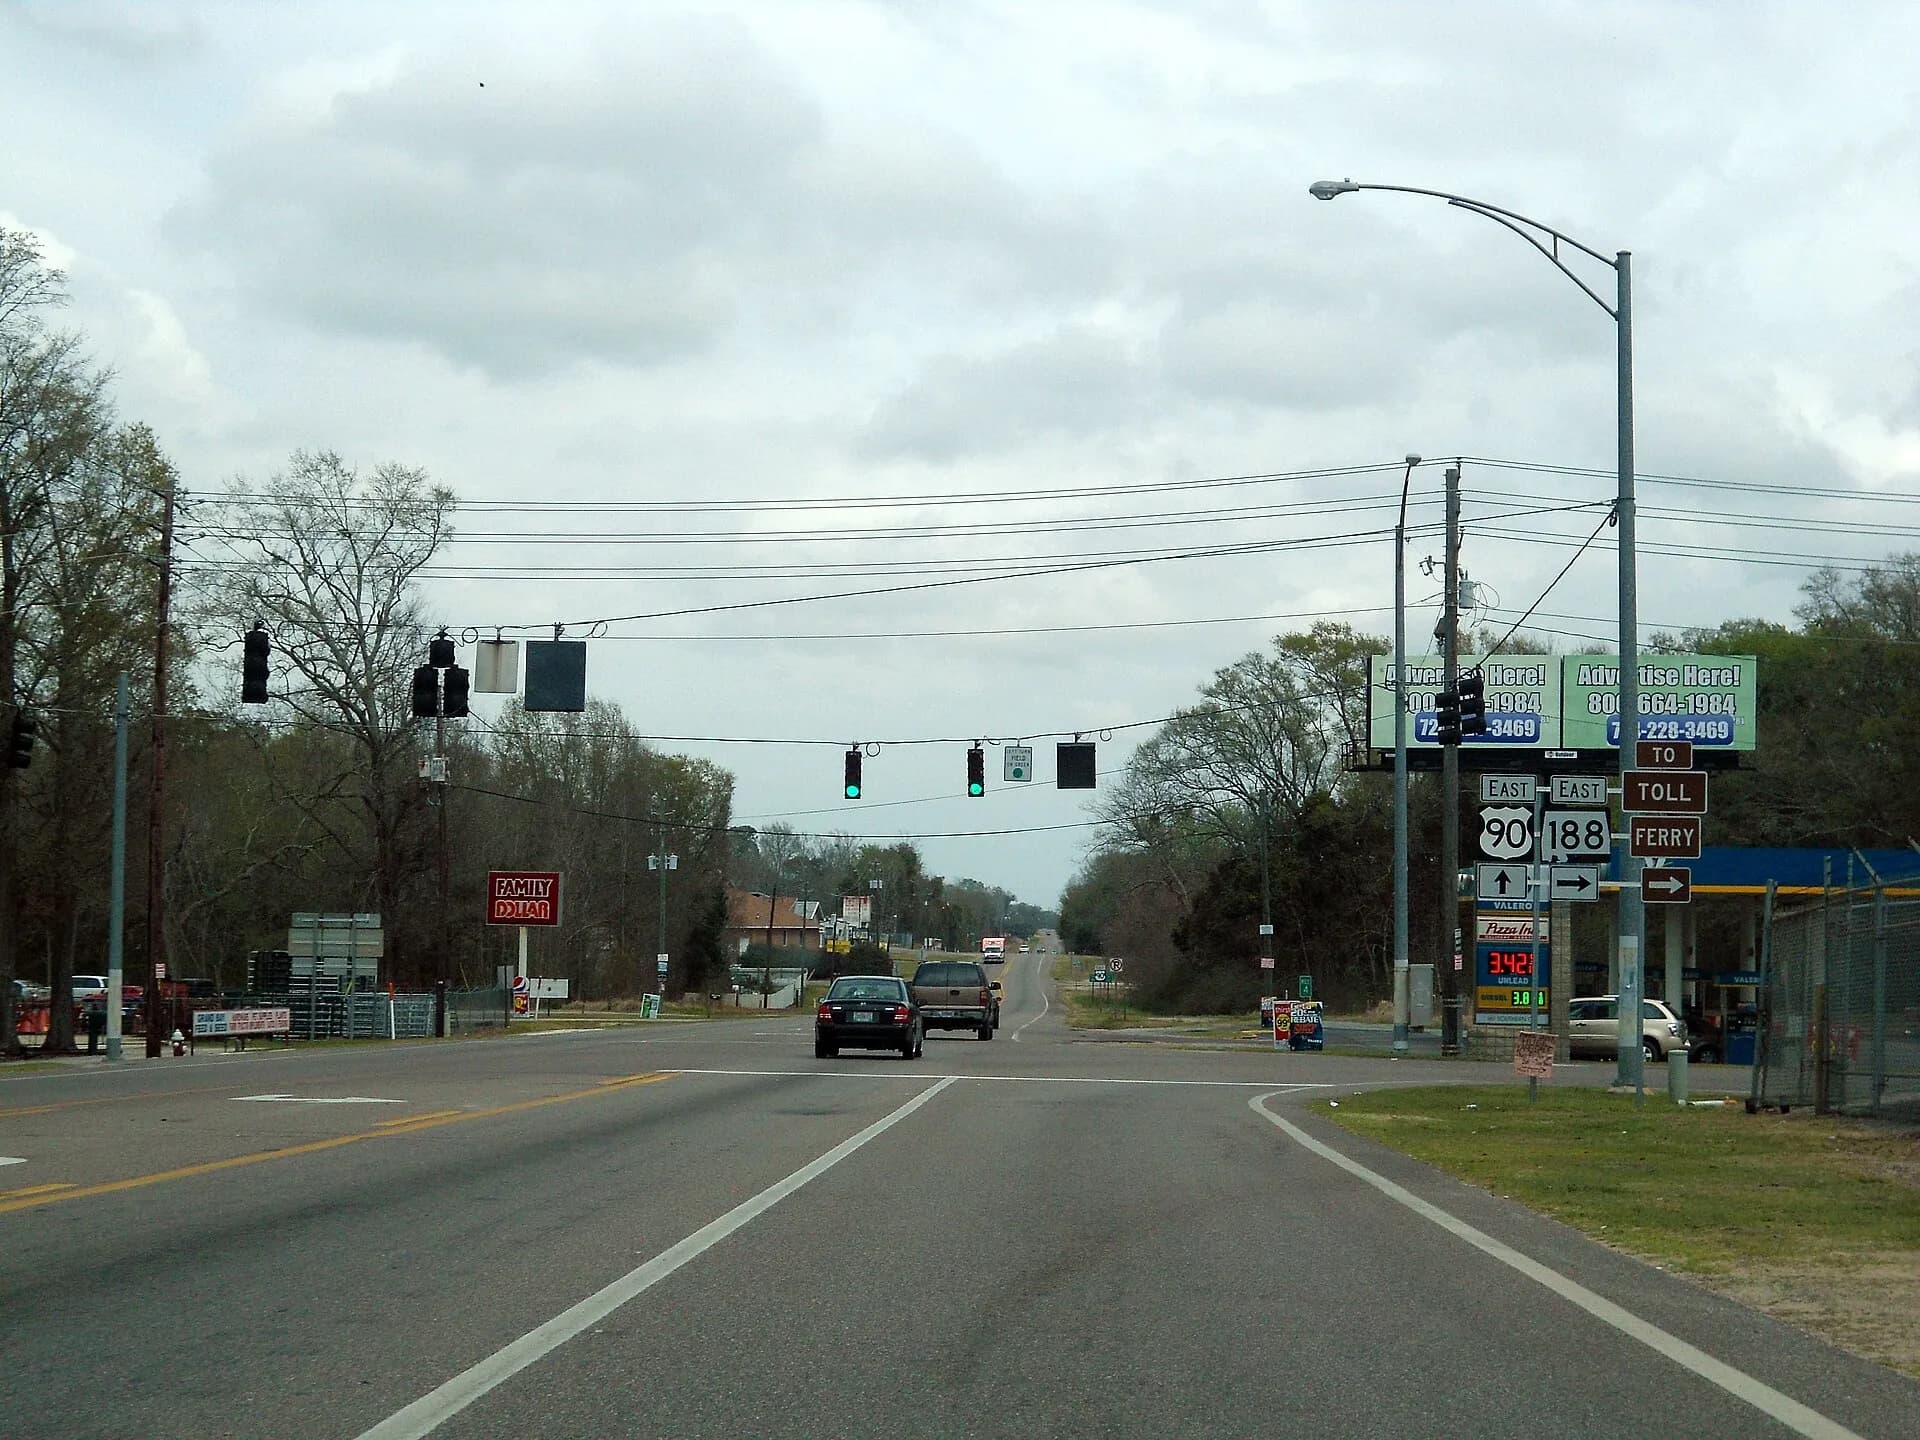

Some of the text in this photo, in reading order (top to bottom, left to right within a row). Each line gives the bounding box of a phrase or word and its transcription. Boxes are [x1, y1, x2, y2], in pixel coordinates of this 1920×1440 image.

[1385, 664, 1545, 687] Averse Here!
[1577, 664, 1741, 687] Advtise Here!
[1588, 691, 1736, 715] 80664-1984
[1612, 721, 1728, 739] 7-228-3469
[1652, 747, 1676, 763] TO
[1489, 780, 1529, 798] EAST
[1559, 781, 1600, 799] EAST
[1638, 783, 1692, 802] TOLL
[1486, 818, 1527, 849] 90
[1548, 819, 1604, 850] 188
[1635, 828, 1694, 846] FERRY
[496, 878, 553, 897] FAMILY
[495, 900, 550, 919] DOLLAR
[1494, 902, 1533, 910] VALERO
[1486, 922, 1518, 934] Pizza
[1498, 977, 1529, 985] UNLEAD
